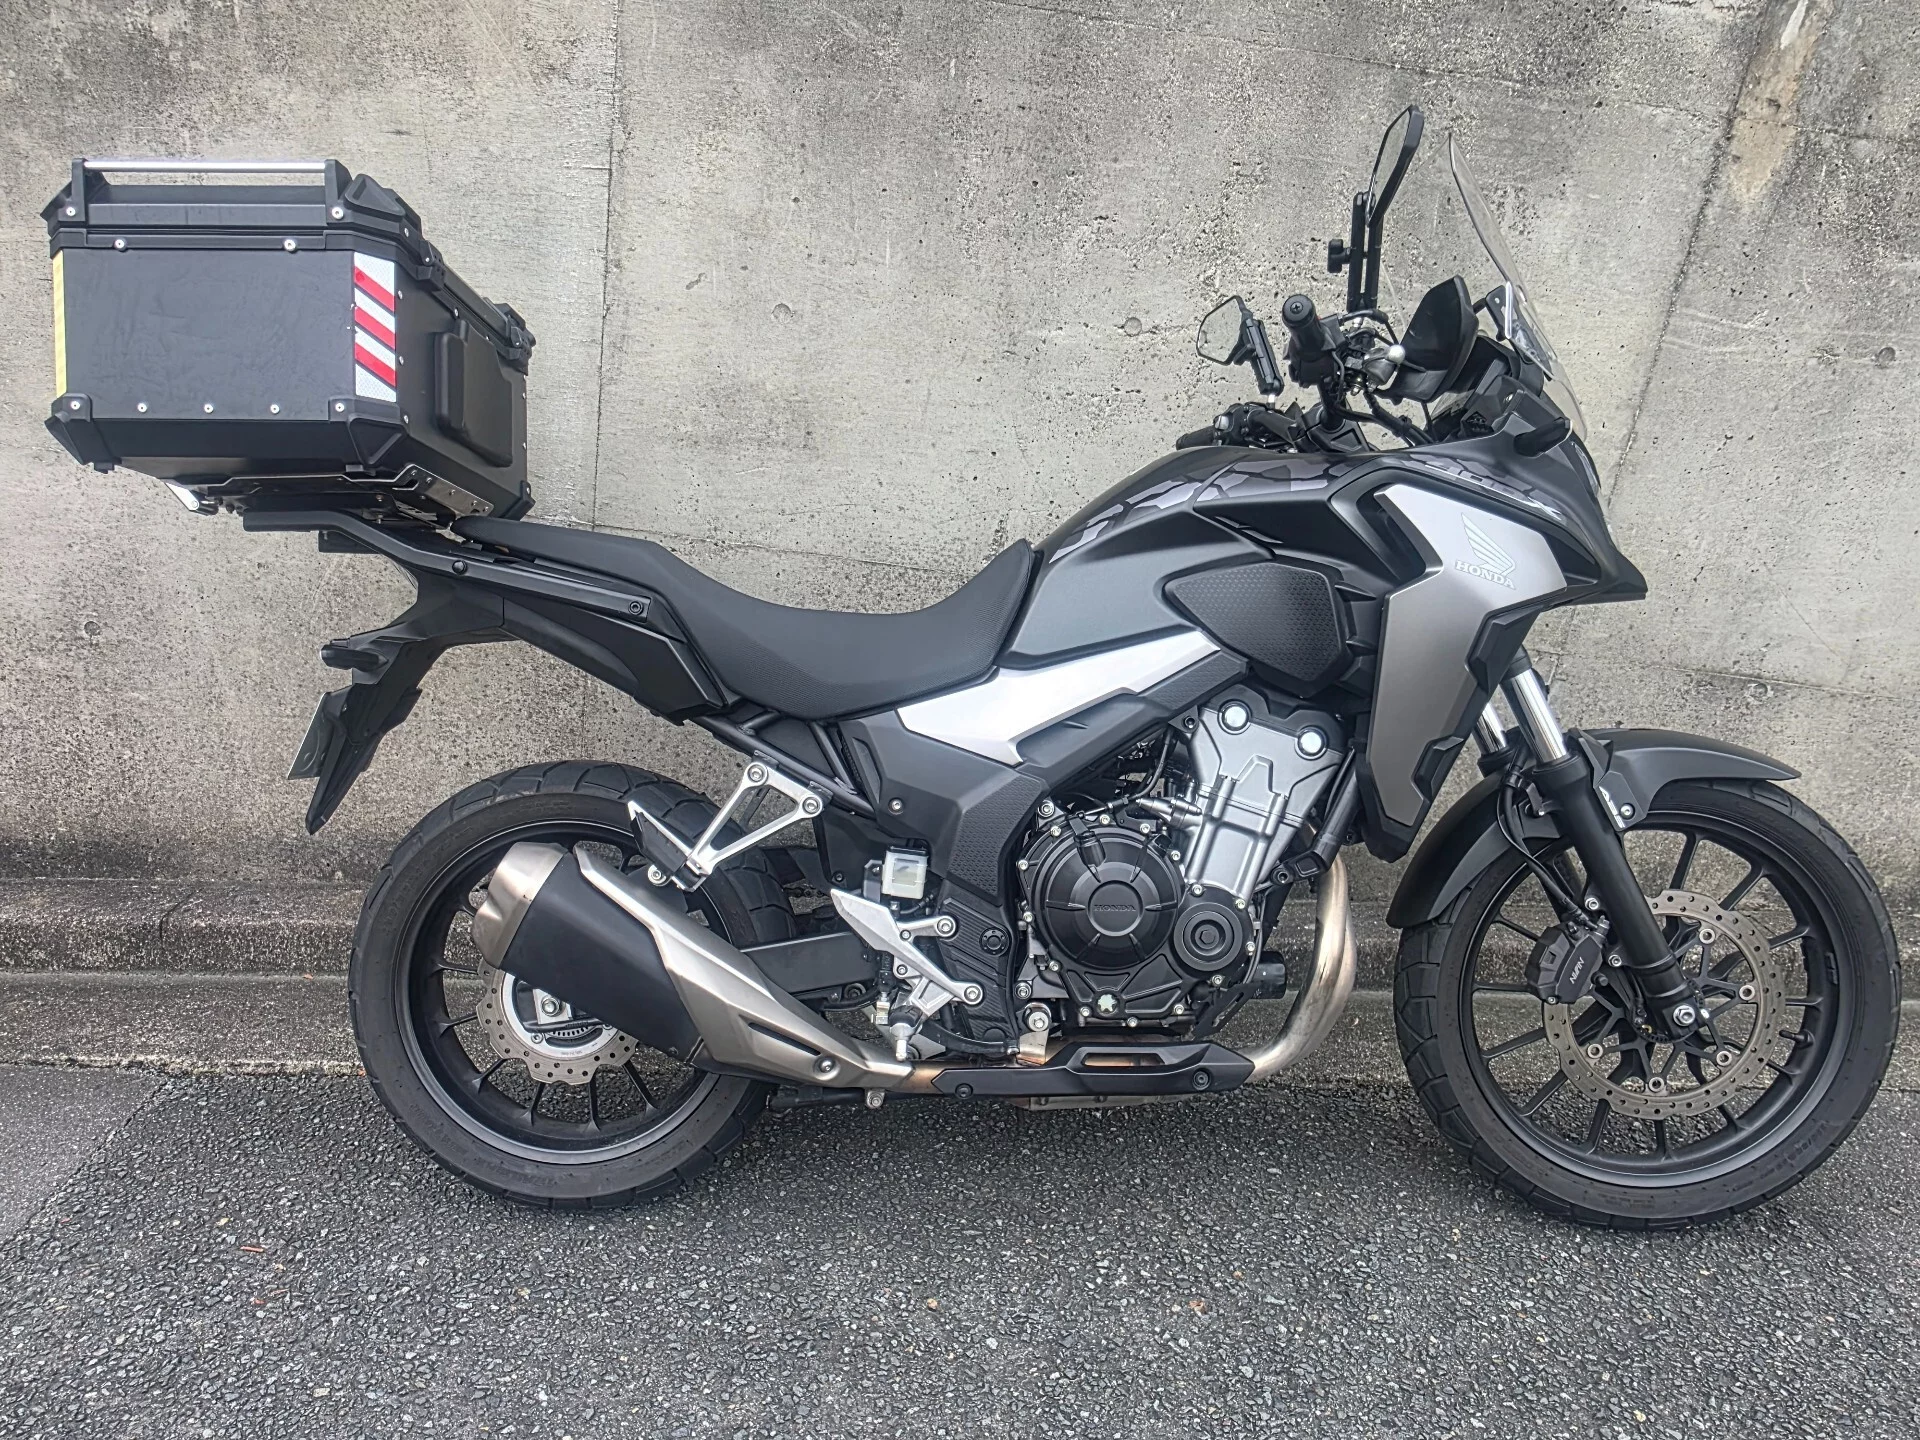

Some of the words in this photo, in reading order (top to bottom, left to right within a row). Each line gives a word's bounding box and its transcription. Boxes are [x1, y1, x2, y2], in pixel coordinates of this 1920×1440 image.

[1454, 560, 1516, 590] HONDA
[1599, 785, 1625, 828] ABS
[1093, 904, 1137, 912] HONDA
